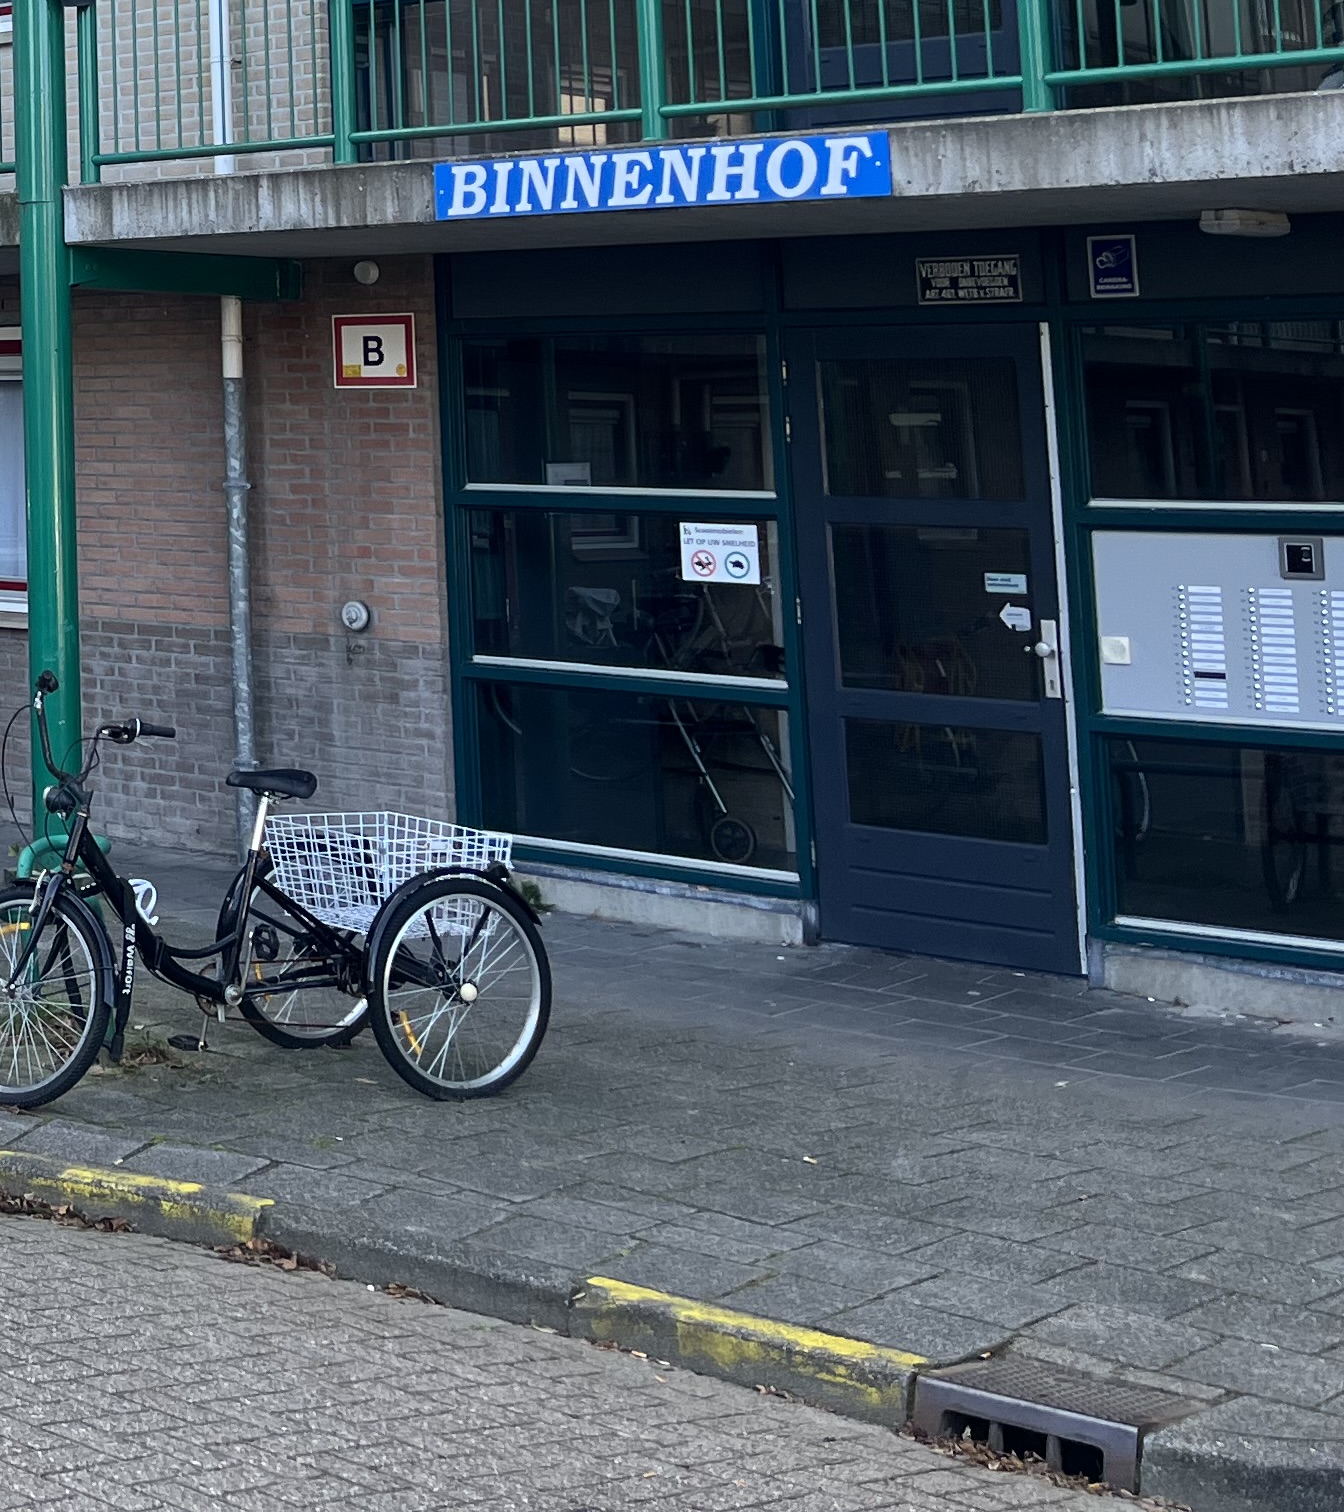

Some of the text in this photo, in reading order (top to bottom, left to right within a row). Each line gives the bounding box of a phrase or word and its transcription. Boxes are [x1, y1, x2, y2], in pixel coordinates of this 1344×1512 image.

[448, 137, 873, 217] BINNENHOF
[920, 260, 1017, 278] VERBODEN TOEGANG
[931, 277, 950, 287] VOOR
[362, 335, 385, 367] B
[122, 944, 136, 995] Walfort
